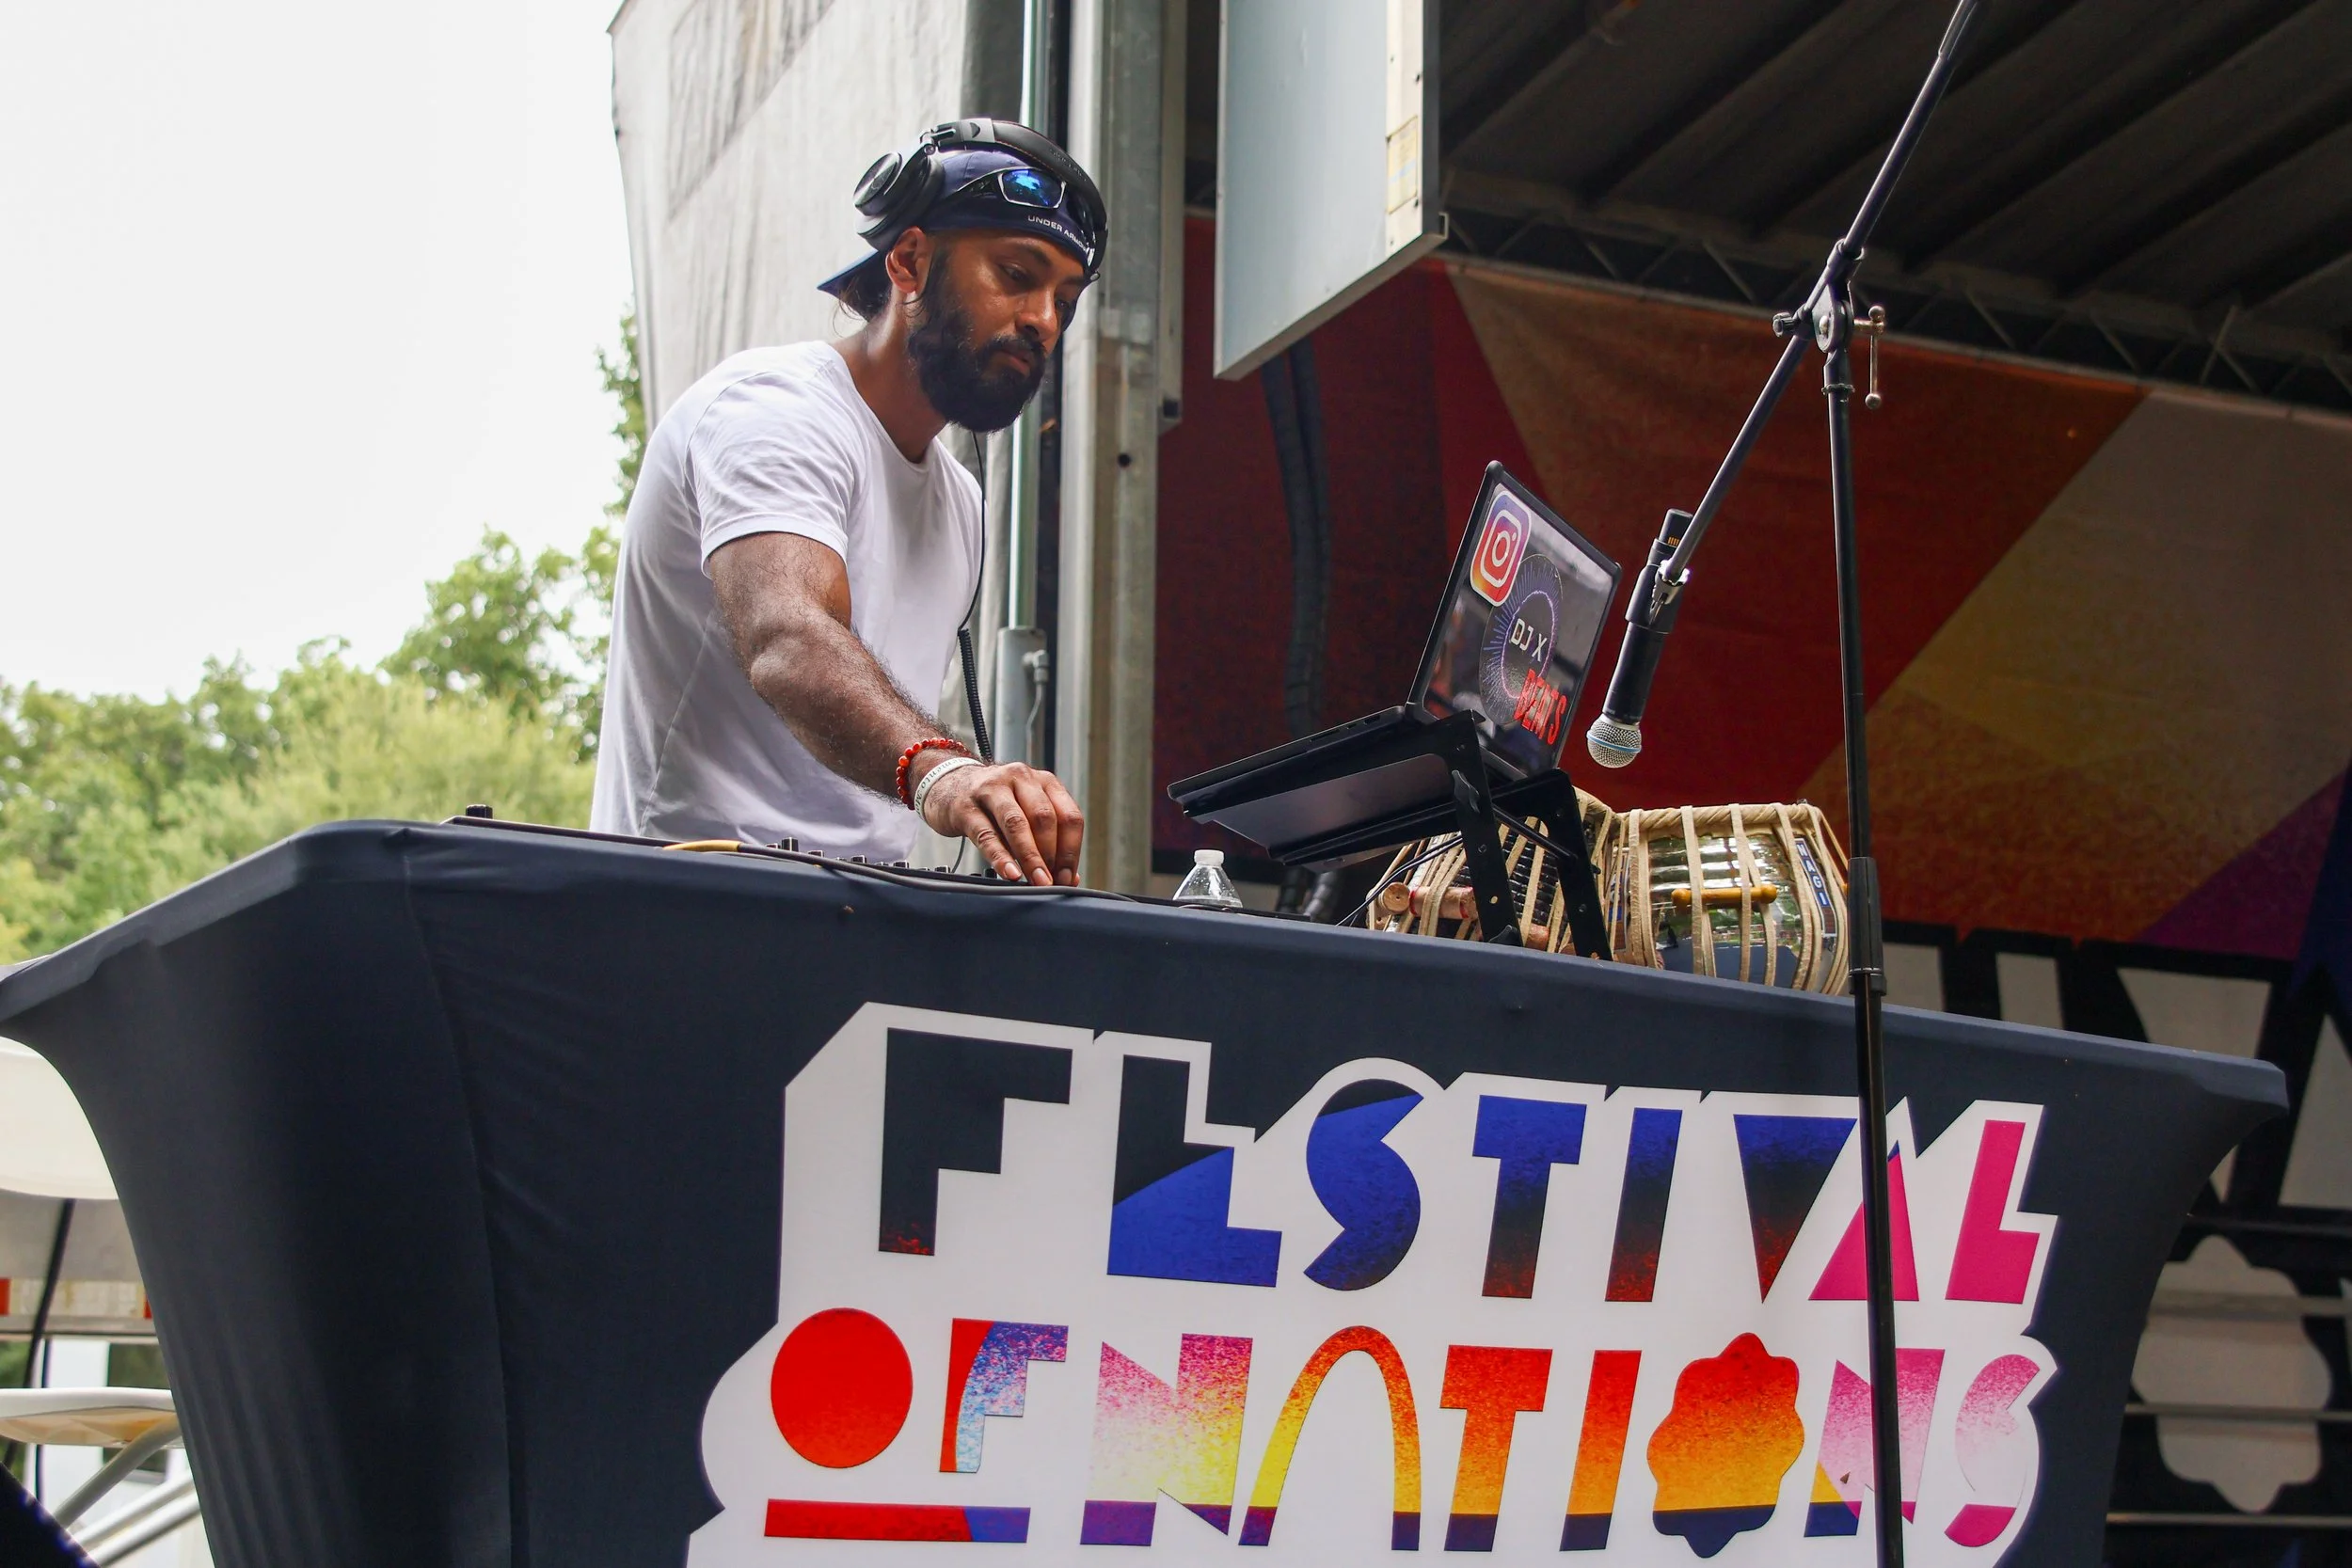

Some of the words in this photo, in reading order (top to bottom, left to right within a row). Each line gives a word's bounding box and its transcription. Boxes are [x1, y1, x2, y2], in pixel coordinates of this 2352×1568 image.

[1027, 214, 1063, 232] UNDER
[1510, 617, 1534, 651] DJ
[1531, 632, 1548, 662] X
[1513, 669, 1567, 745] BEATS
[1796, 843, 1828, 906] NAGI
[878, 1026, 2041, 1305] FESTIVAL
[770, 1307, 1070, 1475] OF
[1079, 1324, 2041, 1560] NATIONS
